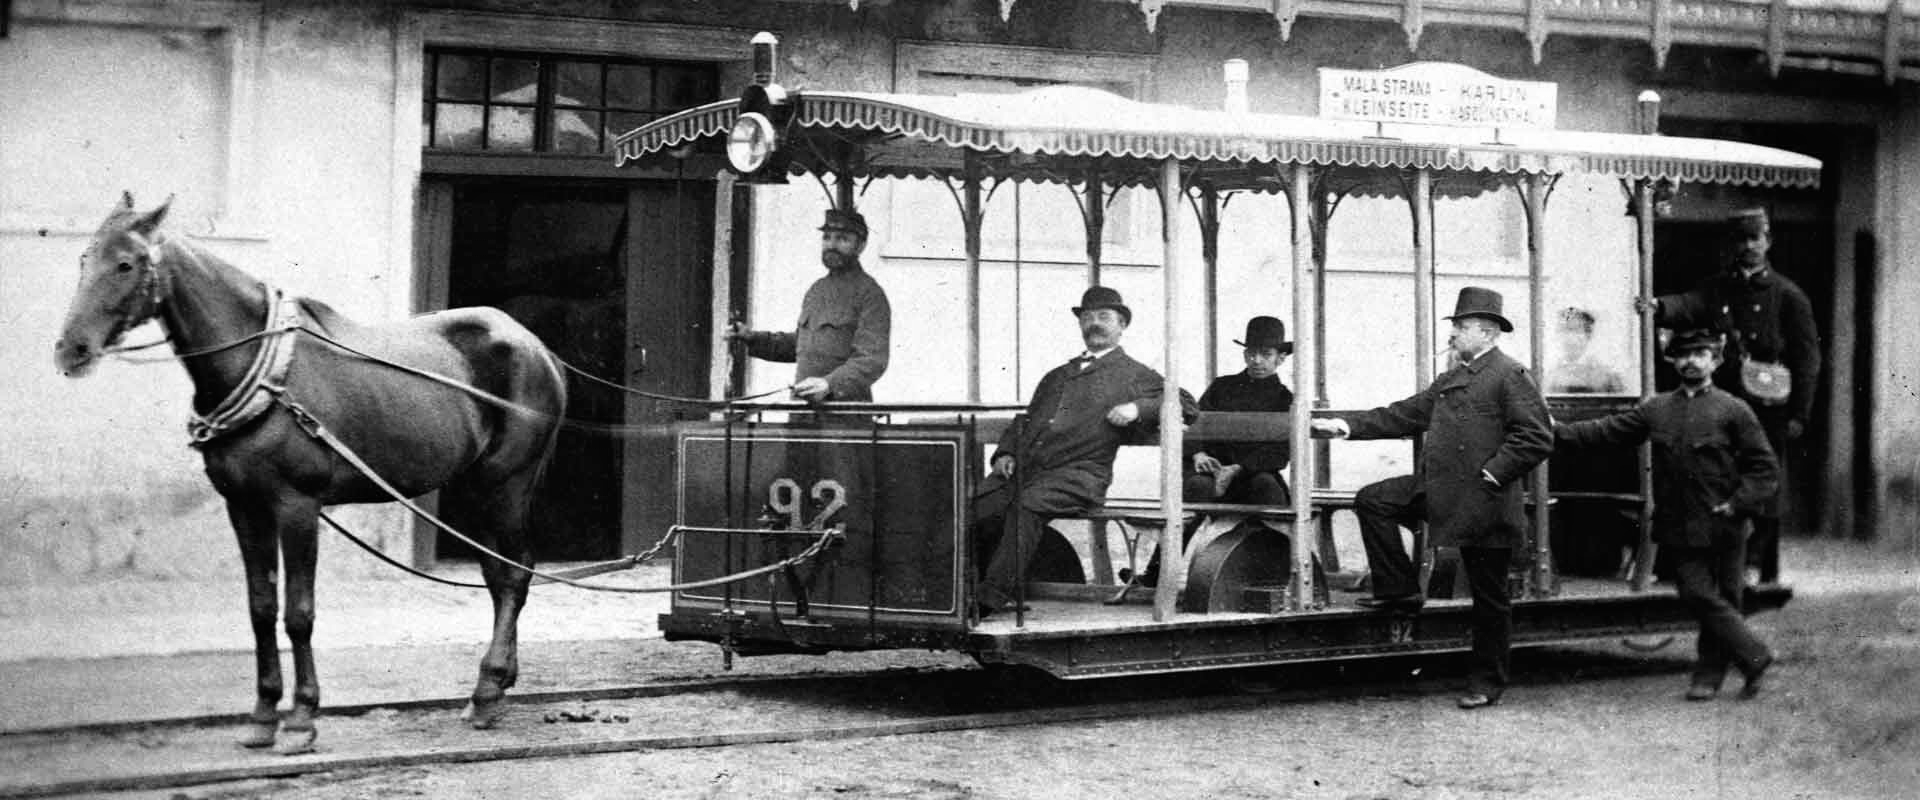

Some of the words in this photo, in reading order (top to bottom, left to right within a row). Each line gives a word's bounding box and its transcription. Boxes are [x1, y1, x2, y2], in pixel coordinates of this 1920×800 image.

[1384, 78, 1431, 96] STRANA
[1460, 84, 1527, 102] KARLIN
[1343, 98, 1429, 119] KLEINSEITE
[769, 478, 847, 532] 92
[1391, 621, 1413, 643] 92
